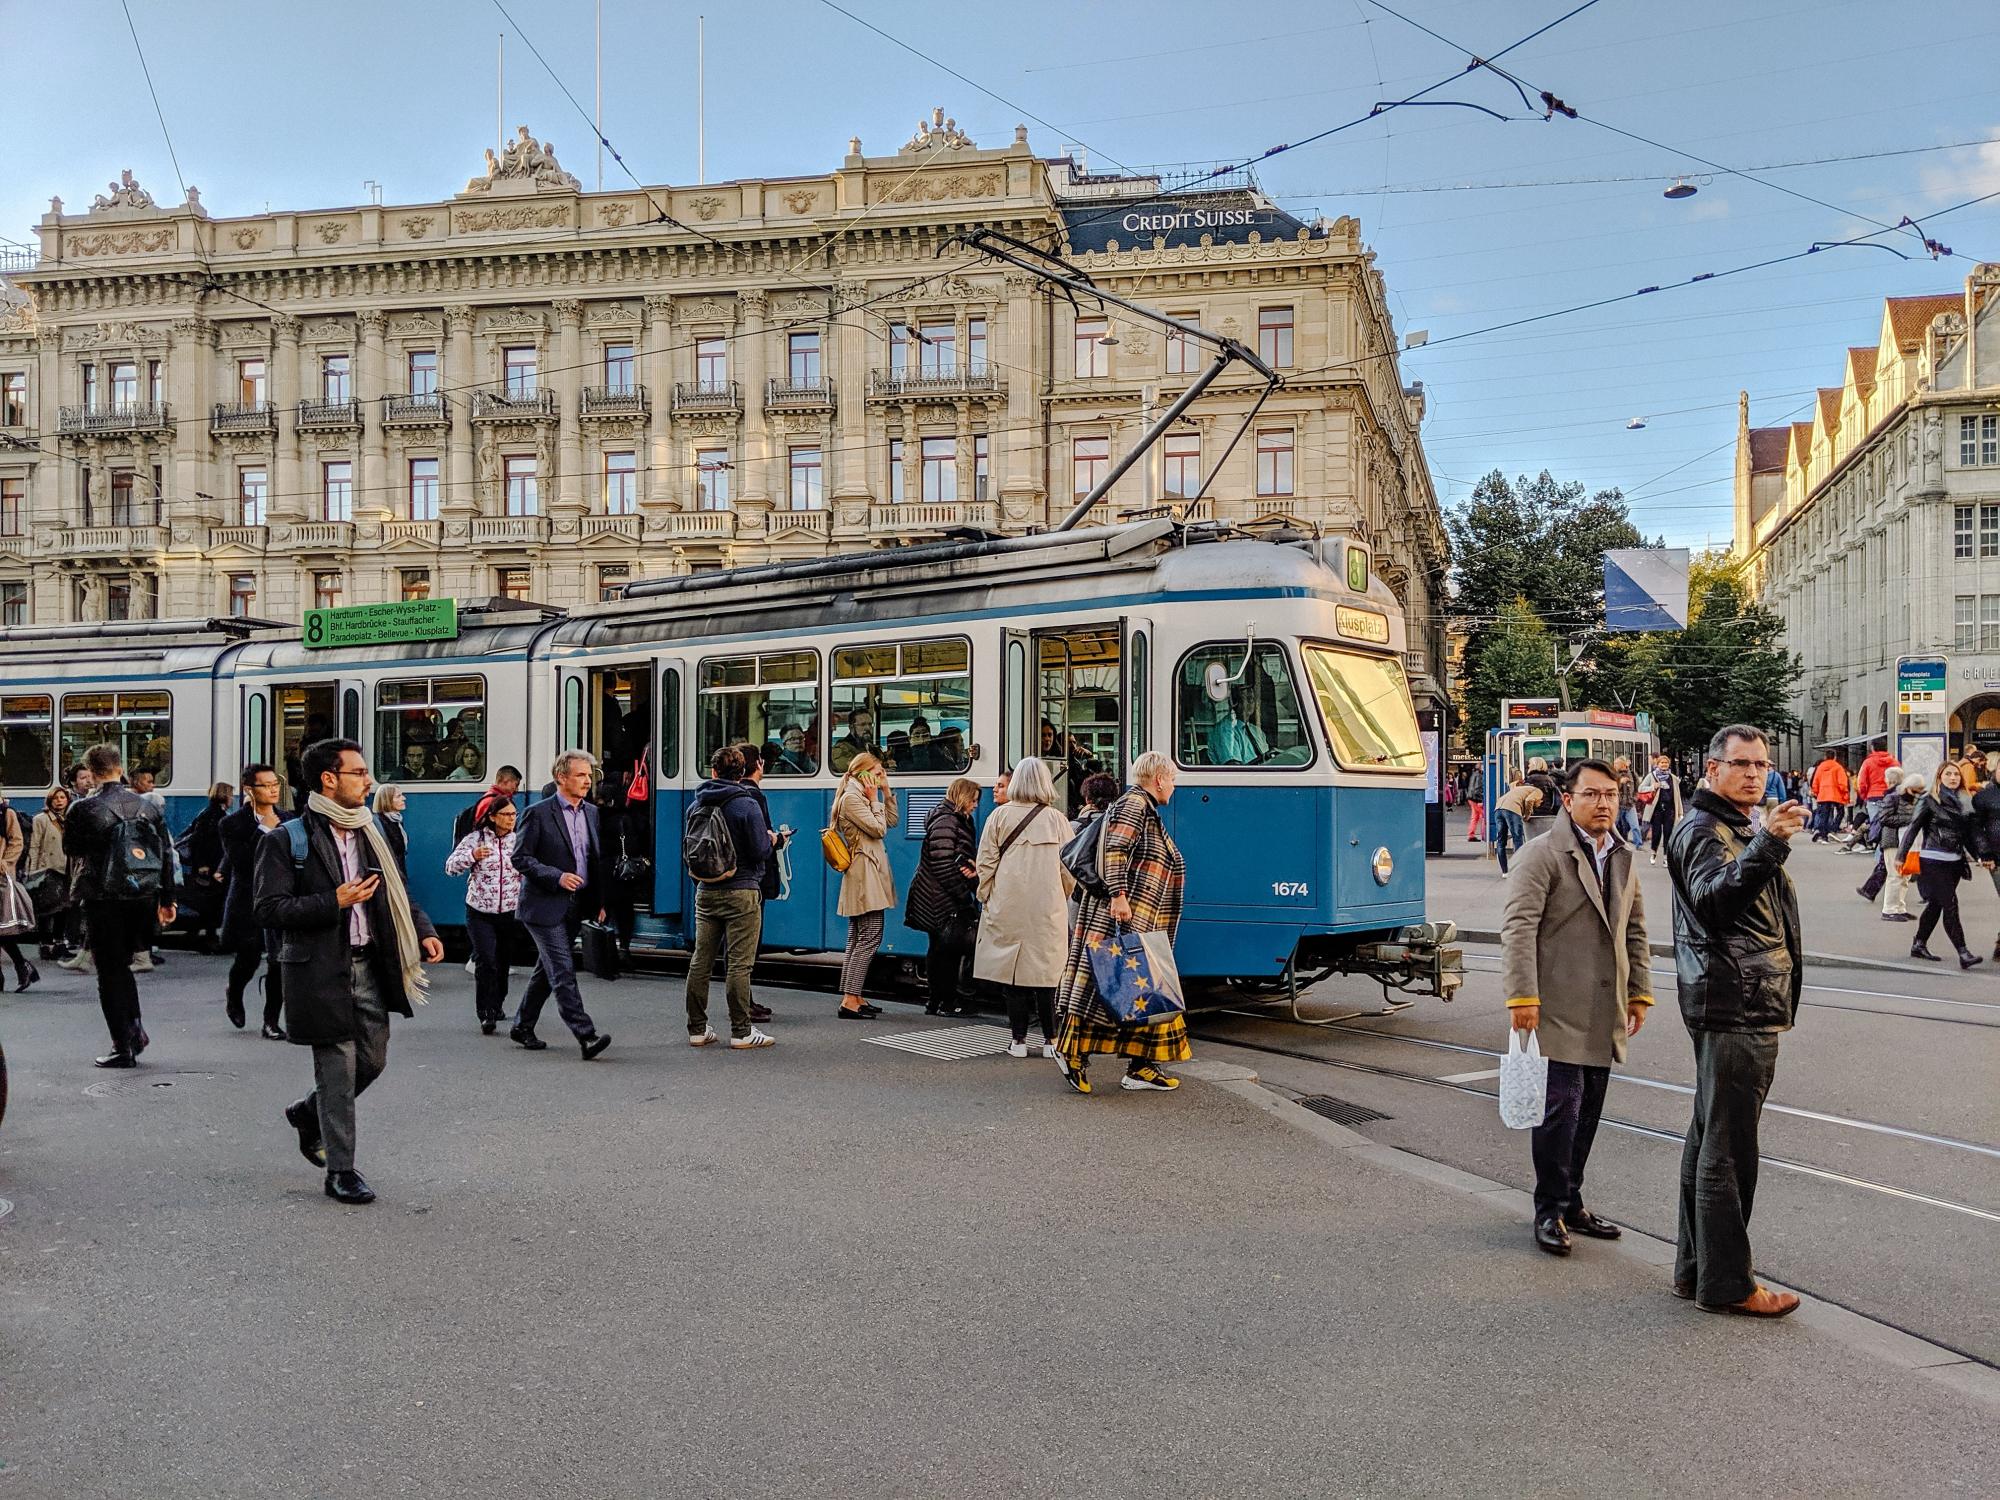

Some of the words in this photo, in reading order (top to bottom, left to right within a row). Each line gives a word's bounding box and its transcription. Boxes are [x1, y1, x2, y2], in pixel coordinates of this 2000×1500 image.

[1122, 213, 1192, 232] CREDIT
[1194, 209, 1255, 228] SUISSE
[1350, 558, 1359, 586] 8
[330, 609, 363, 620] Hardturm
[368, 603, 437, 617] Escher-Wyss-Platz
[307, 613, 323, 643] 8
[330, 622, 344, 631] Bhf.
[346, 618, 387, 630] Hardbrücke
[393, 615, 435, 627] Stauffacher
[1337, 610, 1383, 635] Klusplatz
[330, 631, 372, 643] Paradeplatz
[377, 629, 409, 639] Bellevue
[415, 626, 450, 637] Klusplatz
[1903, 683, 1911, 691] 11
[1271, 882, 1309, 896] 1674
